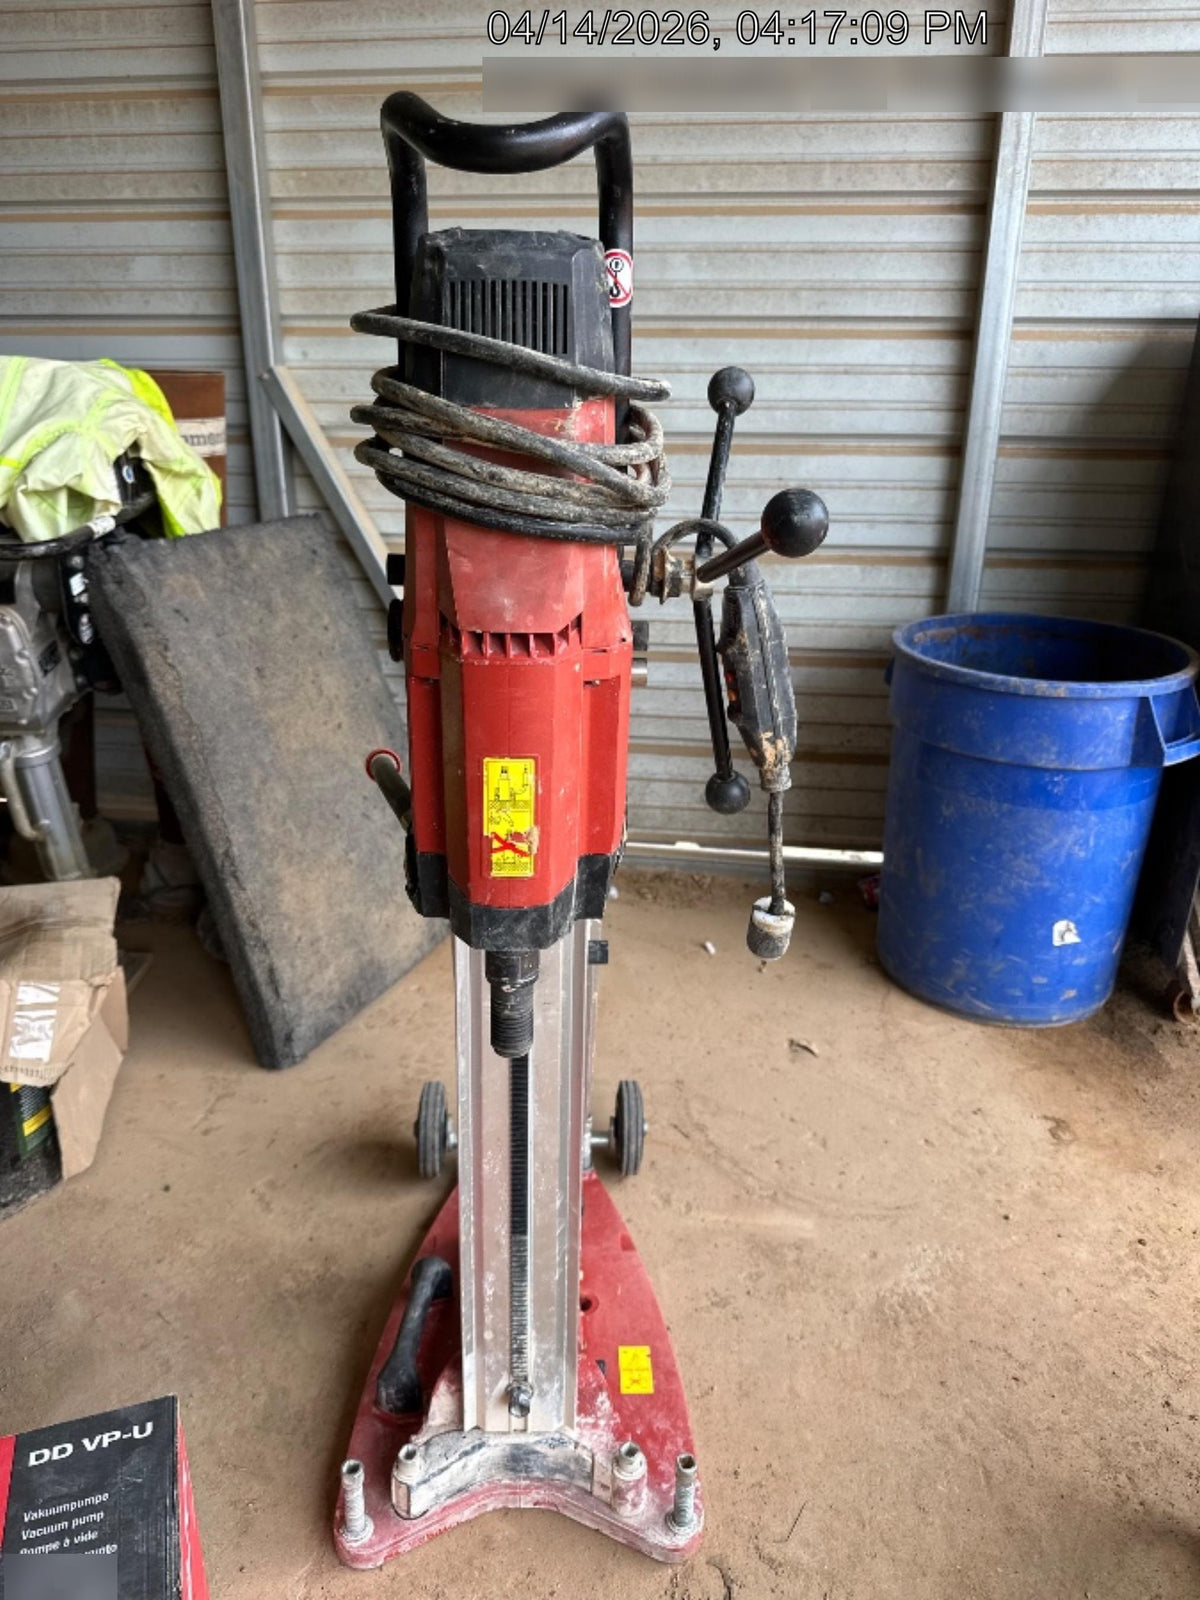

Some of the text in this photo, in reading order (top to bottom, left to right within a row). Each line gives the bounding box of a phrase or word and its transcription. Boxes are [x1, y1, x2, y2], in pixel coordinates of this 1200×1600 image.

[28, 1421, 154, 1467] DD VP-U
[22, 1510, 105, 1541] Vacuum pump
[74, 1530, 99, 1544] vide
